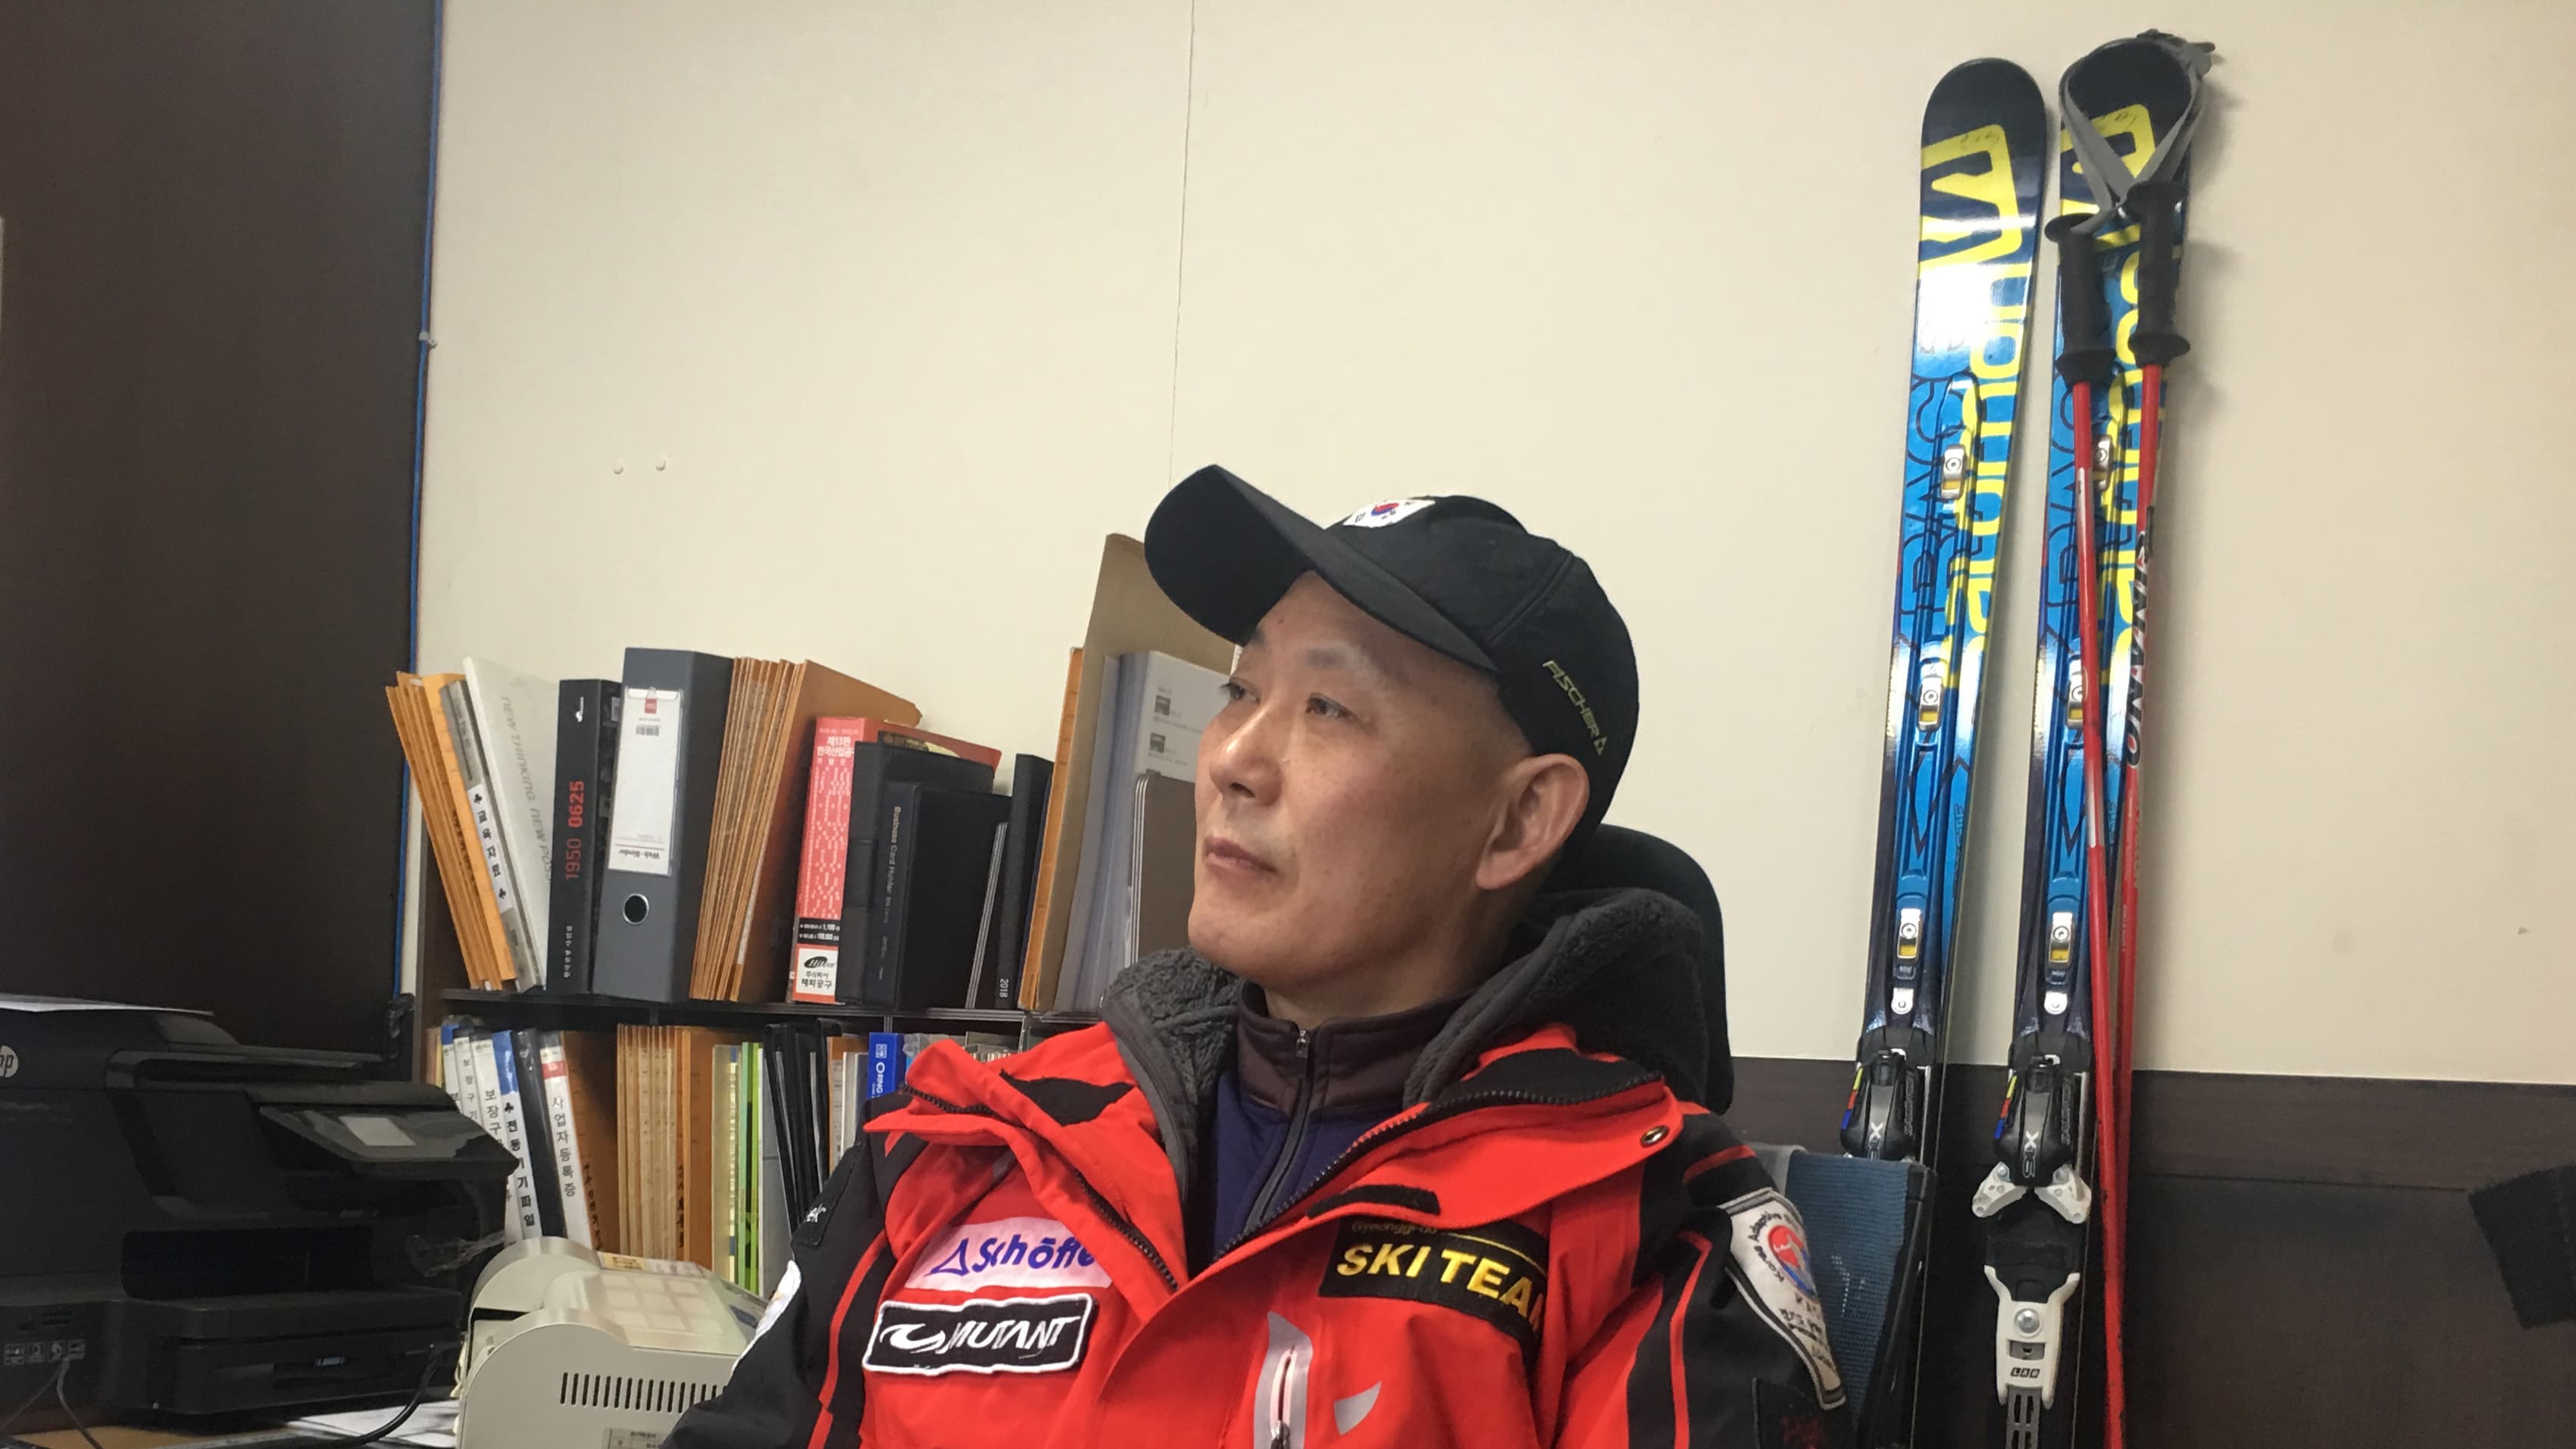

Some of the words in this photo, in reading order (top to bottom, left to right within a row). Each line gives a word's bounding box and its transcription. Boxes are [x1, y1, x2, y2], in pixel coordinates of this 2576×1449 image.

[1542, 660, 1600, 738] FISCHER
[568, 780, 584, 828] 0625
[890, 805, 902, 843] Business
[564, 838, 582, 879] 1950
[888, 845, 898, 865] Card
[999, 978, 1009, 998] 2018
[552, 1096, 576, 1197] 사업자등록증
[1336, 1242, 1431, 1278] SKI
[936, 1316, 1081, 1355] MUTANT
[2010, 1366, 2040, 1379] LAB
